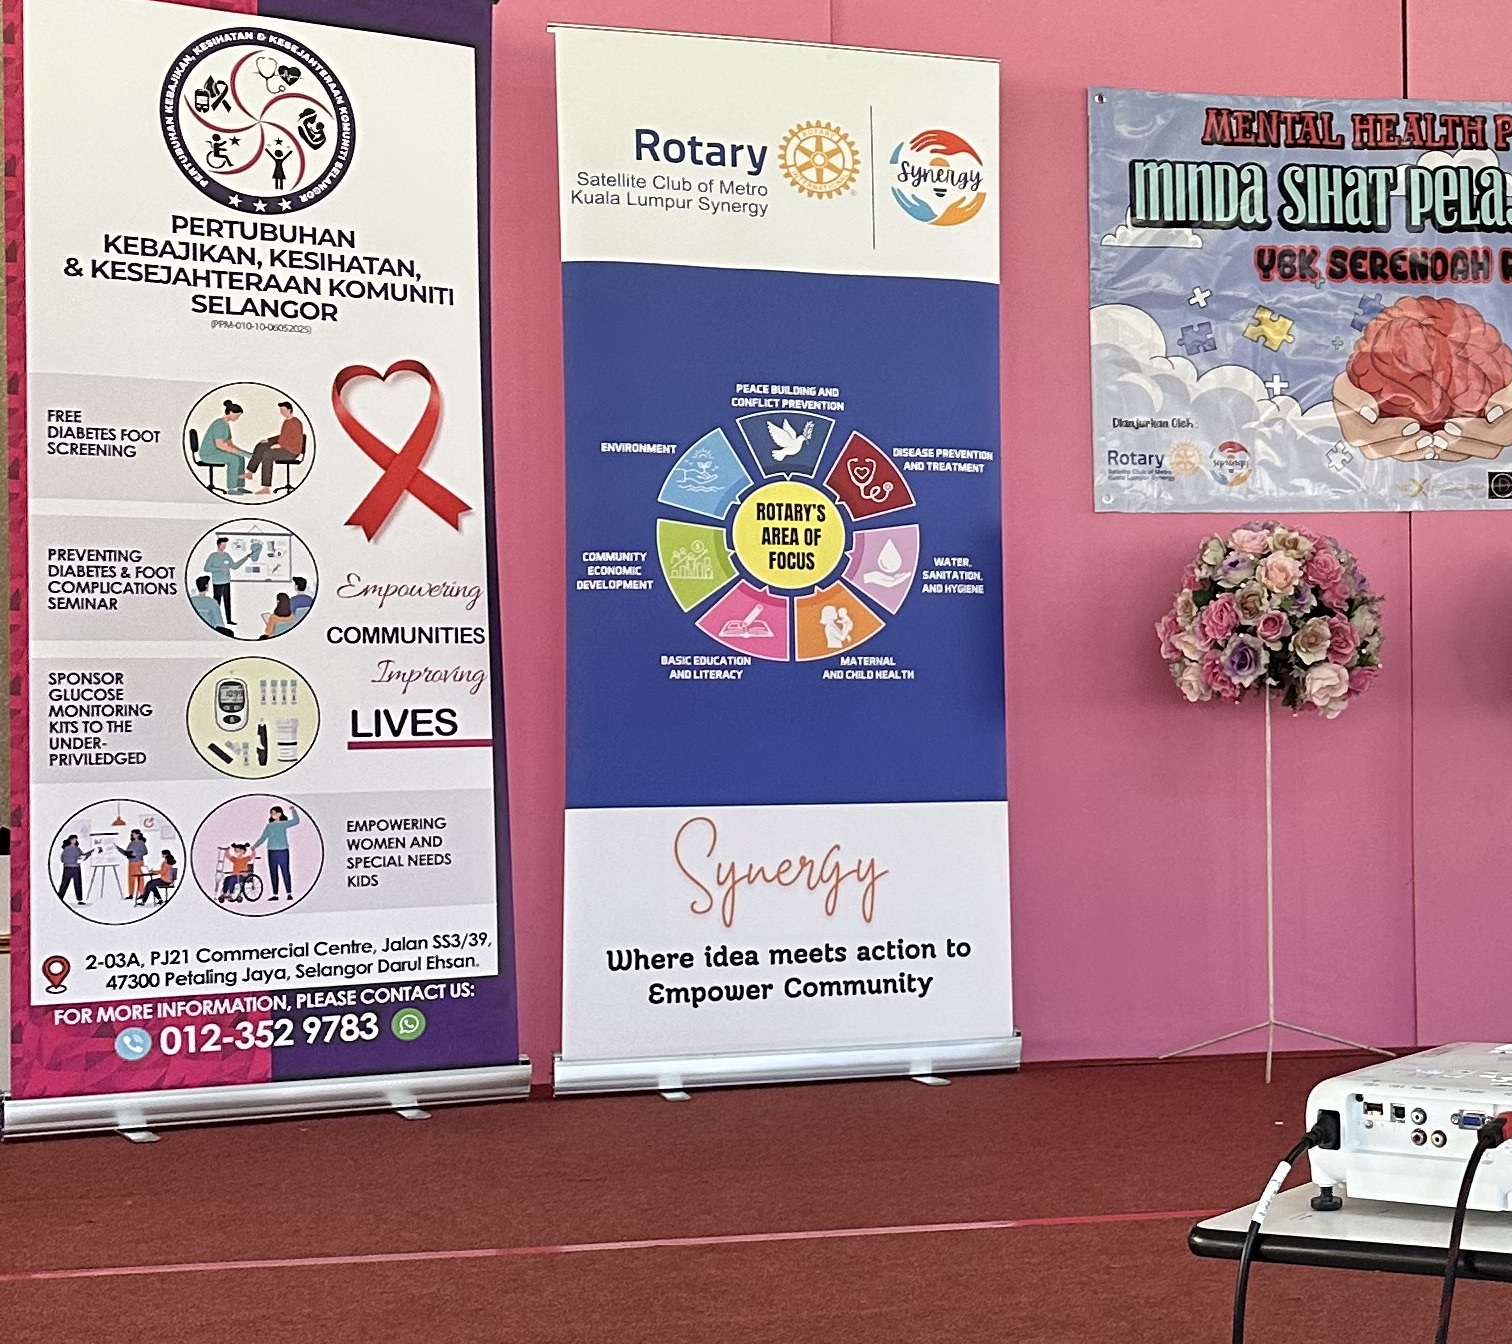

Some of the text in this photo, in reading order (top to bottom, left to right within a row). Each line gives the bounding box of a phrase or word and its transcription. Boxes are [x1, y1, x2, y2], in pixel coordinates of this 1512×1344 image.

[192, 32, 254, 56] KESIHATAN
[269, 35, 345, 105] KESEJAHTERAAN
[338, 107, 351, 161] KOMUNITI
[802, 129, 834, 139] ROTARY
[1202, 108, 1344, 147] MENTAL
[1352, 113, 1487, 150] HEALTH
[165, 116, 209, 188] PERTUBUHAN
[635, 129, 767, 176] Rotary
[299, 161, 344, 203] SELANGOR
[577, 172, 768, 196] Satellite Club of Metro
[792, 170, 849, 191] INTERNATIONAL
[897, 161, 983, 191] Synergy
[571, 190, 768, 217] Kuala Lumpur Synergy
[171, 215, 355, 248] PERTUBUHAN
[104, 234, 421, 280] KEBAJIKAN, KESIHATAN,
[1328, 247, 1491, 282] SERENDAH
[64, 258, 454, 305] & KESEJAHTERAAN KOMUNITI
[192, 295, 337, 321] SELANGOR
[736, 384, 839, 397] PEACE BUILDING AND
[731, 398, 844, 411] CONFLICT PREVENTION
[48, 410, 82, 423] FREE
[48, 426, 160, 443] DIABETES FOOT
[47, 442, 136, 457] SCREENING
[601, 442, 676, 454] ENVIRONMENT
[893, 448, 993, 460] DISEASE PREVENTION
[903, 462, 984, 473] AND TREATMENT
[1108, 450, 1165, 468] Rotary
[756, 503, 826, 521] ROTARY'S
[762, 528, 822, 546] AREA OF
[48, 549, 142, 562] PREVENTING
[582, 552, 647, 562] COMMUNITY
[769, 552, 815, 569] FOCUS
[48, 565, 175, 579] DIABETES & FOOT
[588, 566, 642, 576] ECONOMIC
[48, 581, 177, 595] COMPLICATIONS
[337, 573, 483, 610] Empowering
[576, 580, 653, 589] DEVELOPMENT
[922, 584, 984, 594] AND HYGIENE
[48, 598, 117, 609] SEMINAR
[327, 627, 485, 644] COMMUNITIES
[661, 656, 751, 666] BASIC EDUCATION
[840, 656, 895, 666] MATERNAL
[48, 672, 124, 685] SPONSOR
[371, 660, 487, 695] Improving
[669, 670, 743, 680] AND LITERACY
[822, 670, 914, 679] AND CHILD HEALTH
[49, 689, 124, 701] GLUCOSE
[48, 704, 152, 717] MONITORING
[50, 720, 132, 733] KITS TO THE
[351, 709, 457, 737] LIVES
[50, 737, 107, 750] UNDER-
[49, 752, 146, 766] PRIVILEDGED
[347, 817, 446, 832] EMPOWERING
[346, 836, 442, 850] WOMEN AND
[347, 853, 451, 869] SPECIAL NEEDS
[347, 875, 378, 887] KIDS
[674, 817, 889, 928] Synergy
[86, 933, 492, 970] 2-03A, PJ21 Commercial Centre, Jalan SS3/39,
[607, 939, 971, 971] Where idea meets action to
[106, 955, 479, 990] 47300 Petaling Jaya, Selangor Darul Ehsan.
[649, 972, 933, 1008] Empower Community
[54, 982, 474, 1025] FOR MORE INFORMATION, PLEASE CONTACT US:
[160, 1012, 379, 1055] 012-352 9783
